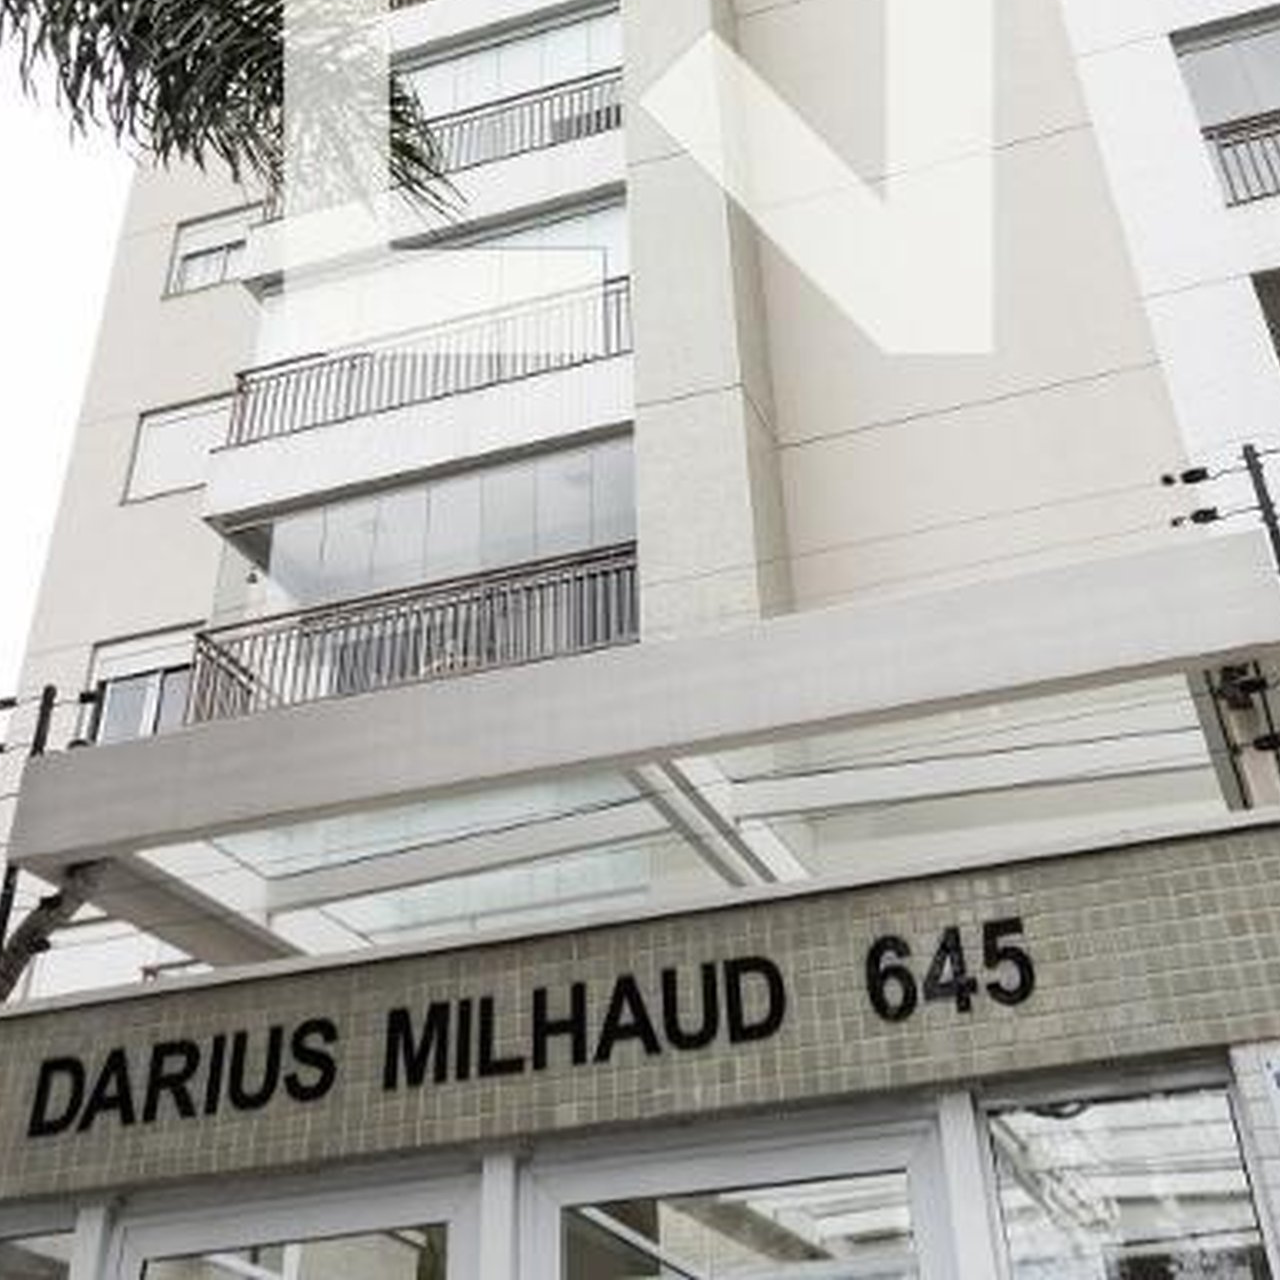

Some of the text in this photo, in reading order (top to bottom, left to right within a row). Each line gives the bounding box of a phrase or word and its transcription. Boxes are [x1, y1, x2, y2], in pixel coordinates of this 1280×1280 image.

[25, 916, 1037, 1140] DARIUS MILHAUD 645
